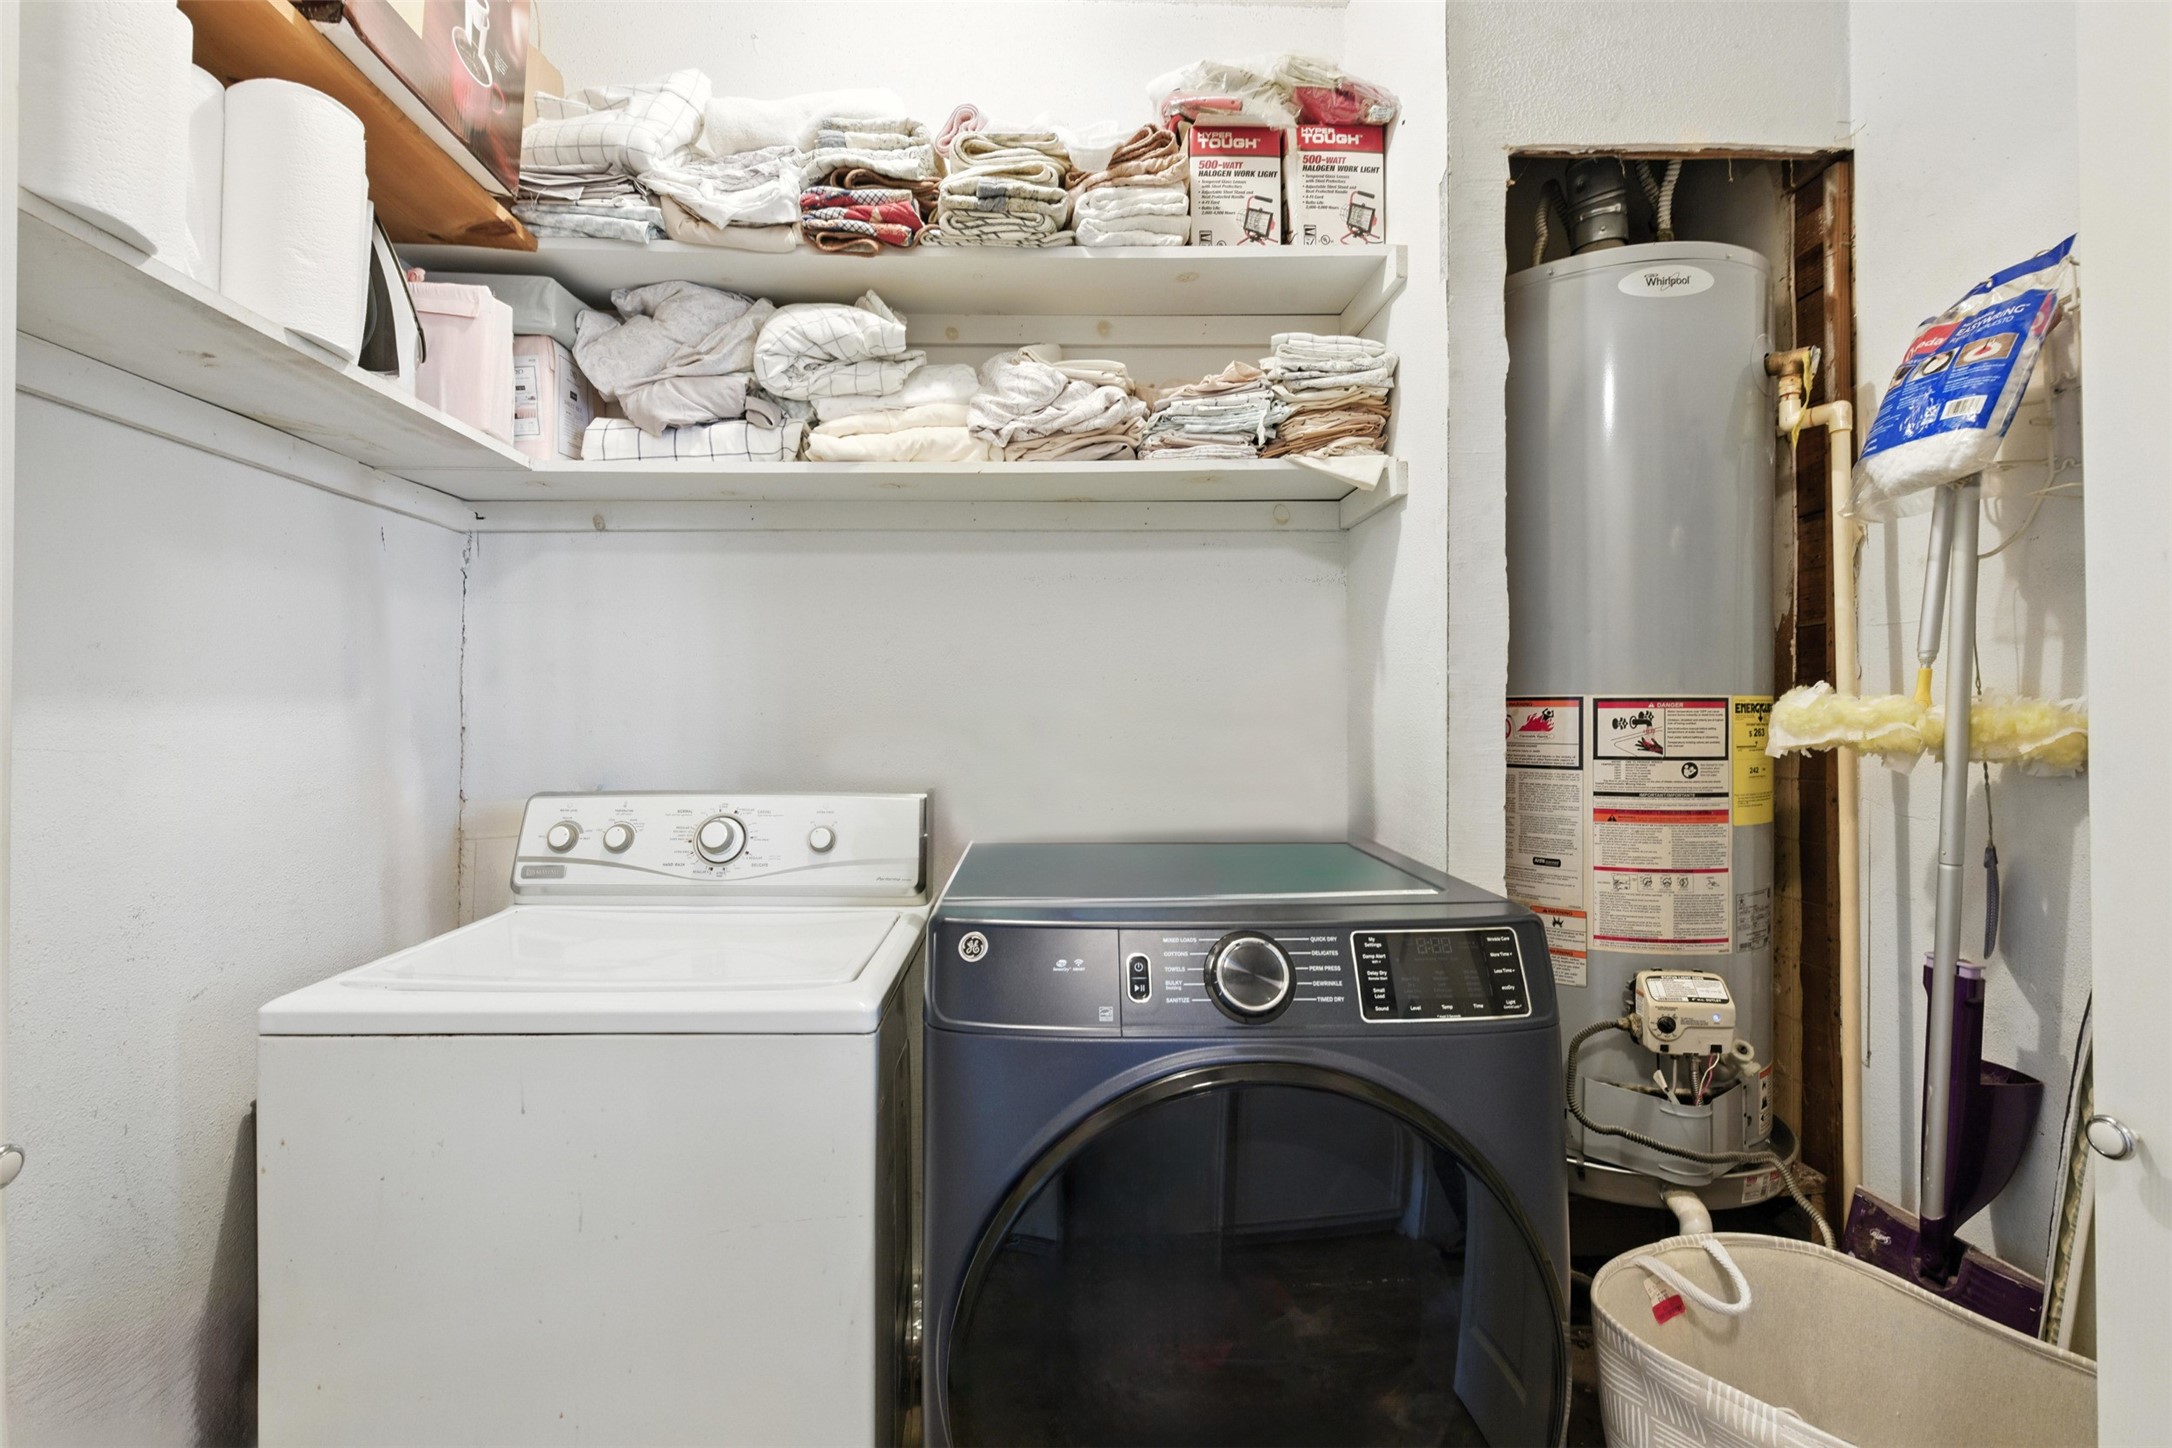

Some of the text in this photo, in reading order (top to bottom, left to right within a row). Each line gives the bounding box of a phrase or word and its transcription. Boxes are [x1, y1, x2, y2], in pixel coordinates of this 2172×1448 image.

[1198, 138, 1257, 149] TOUGH
[1301, 134, 1360, 145] TOUGH
[1198, 160, 1244, 169] 500-WATT
[1302, 155, 1347, 164] 500-WATT
[1645, 276, 1690, 287] Whirlpool
[1754, 728, 1765, 737] 263
